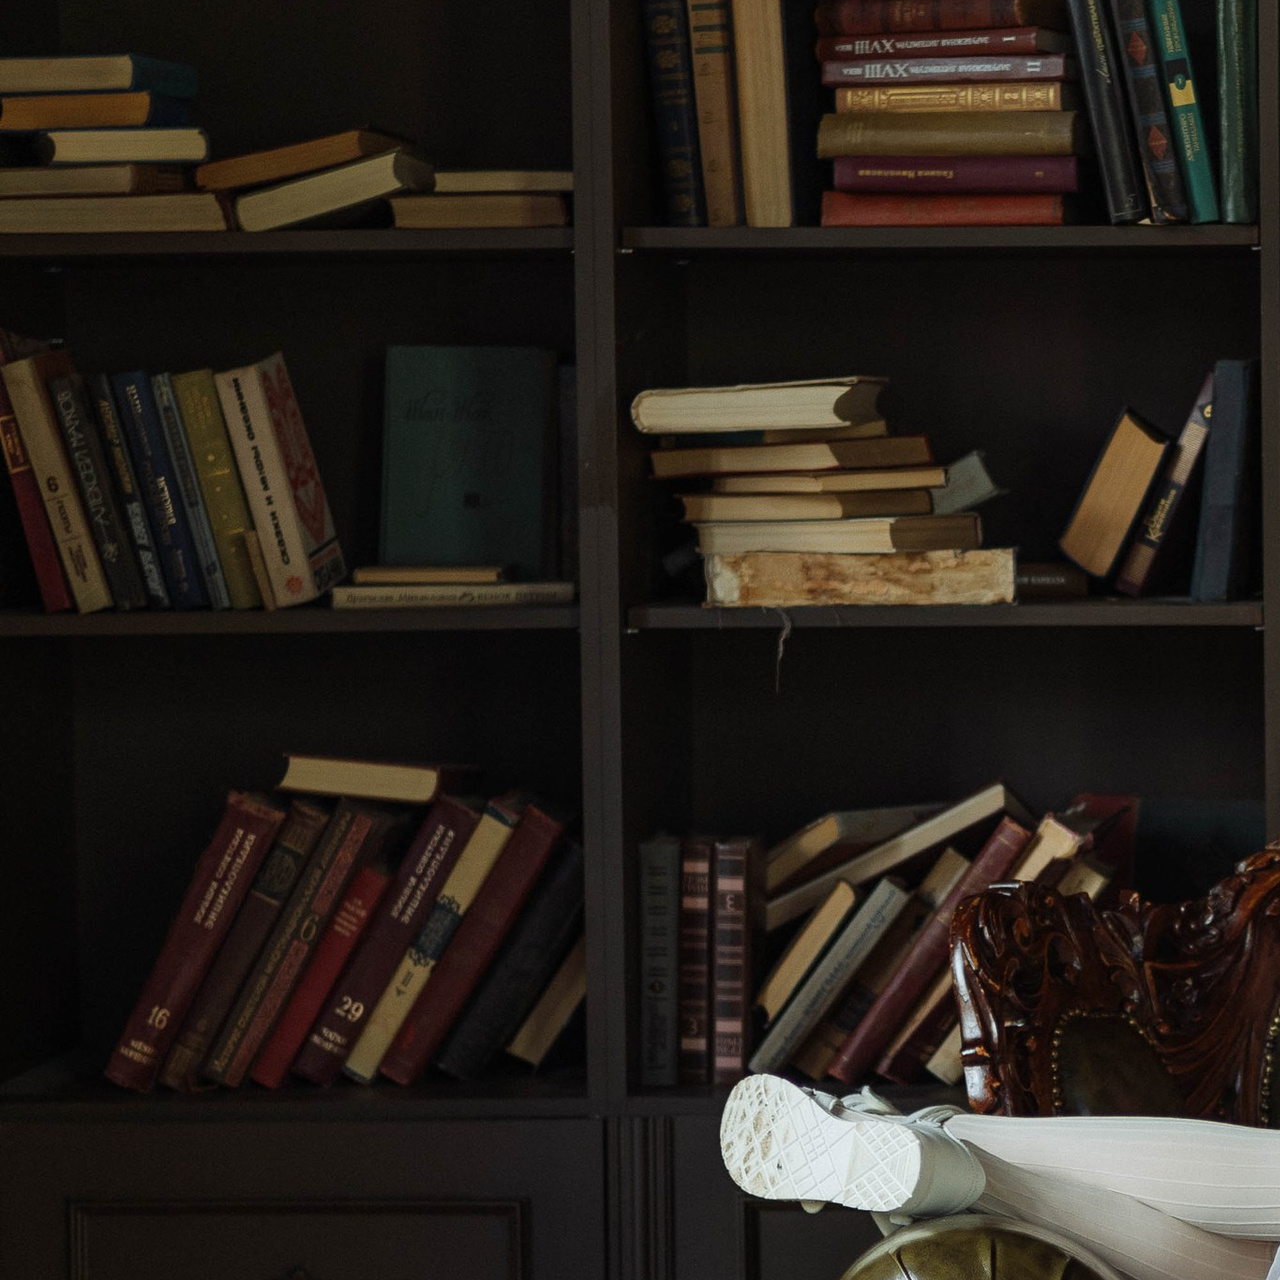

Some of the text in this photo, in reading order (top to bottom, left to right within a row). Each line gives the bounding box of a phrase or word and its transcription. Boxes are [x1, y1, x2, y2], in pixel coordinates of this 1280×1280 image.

[833, 34, 990, 56] ЗАРУБЕЖНАЯ ЛИТЕРАТУРА XVIII ВЕКА
[1157, 12, 1177, 54] ИЗБРАННЫЕ
[841, 60, 1011, 80] ЗАРУБЕЖНАЯ ЛИТЕРАТУРА XVIII ВЕКА
[857, 169, 954, 178] Галина Николаева
[70, 448, 112, 529] АЛЕКСЕЙ
[264, 494, 274, 506] и
[213, 826, 245, 880] СОВЕТСКАЯ
[413, 823, 446, 876] СОВЕТСКАЯ
[203, 831, 257, 930] ЭНЦИКЛОПЕДИЯ
[399, 828, 456, 926] ЭНЦИКЛОПЕДИЯ
[146, 1003, 172, 1031] 16
[331, 992, 367, 1024] 29
